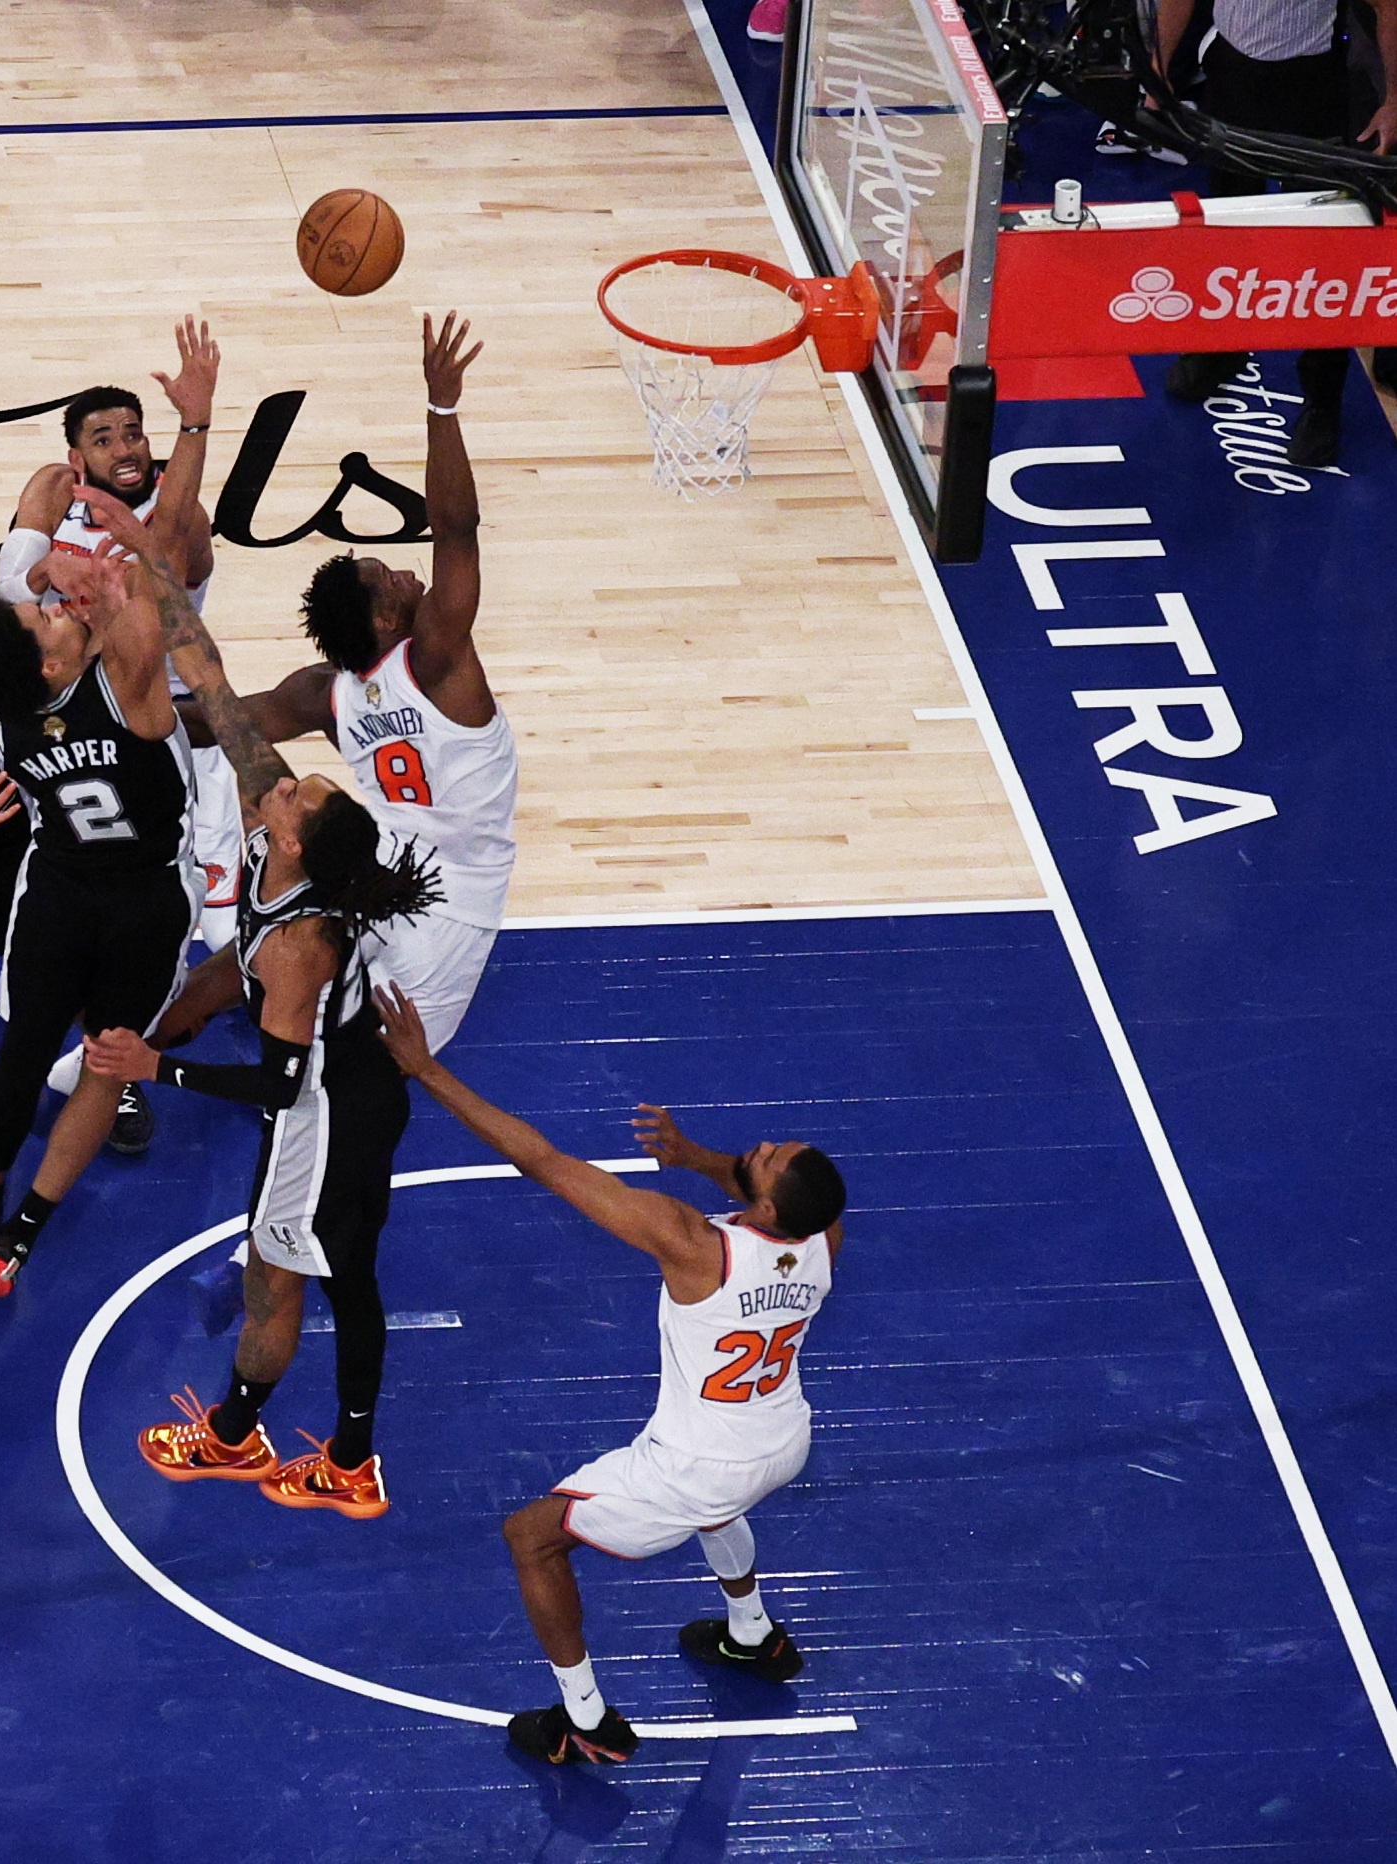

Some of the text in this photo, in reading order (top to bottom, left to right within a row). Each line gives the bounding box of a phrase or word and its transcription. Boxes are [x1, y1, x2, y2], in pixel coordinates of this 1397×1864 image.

[1349, 266, 1397, 318] Fa
[987, 445, 1278, 856] ULTRA
[19, 739, 119, 782] HARPER
[373, 739, 434, 807] 8
[55, 778, 140, 843] 2
[738, 1282, 818, 1319] BRIDGES
[700, 1316, 810, 1404] 25
